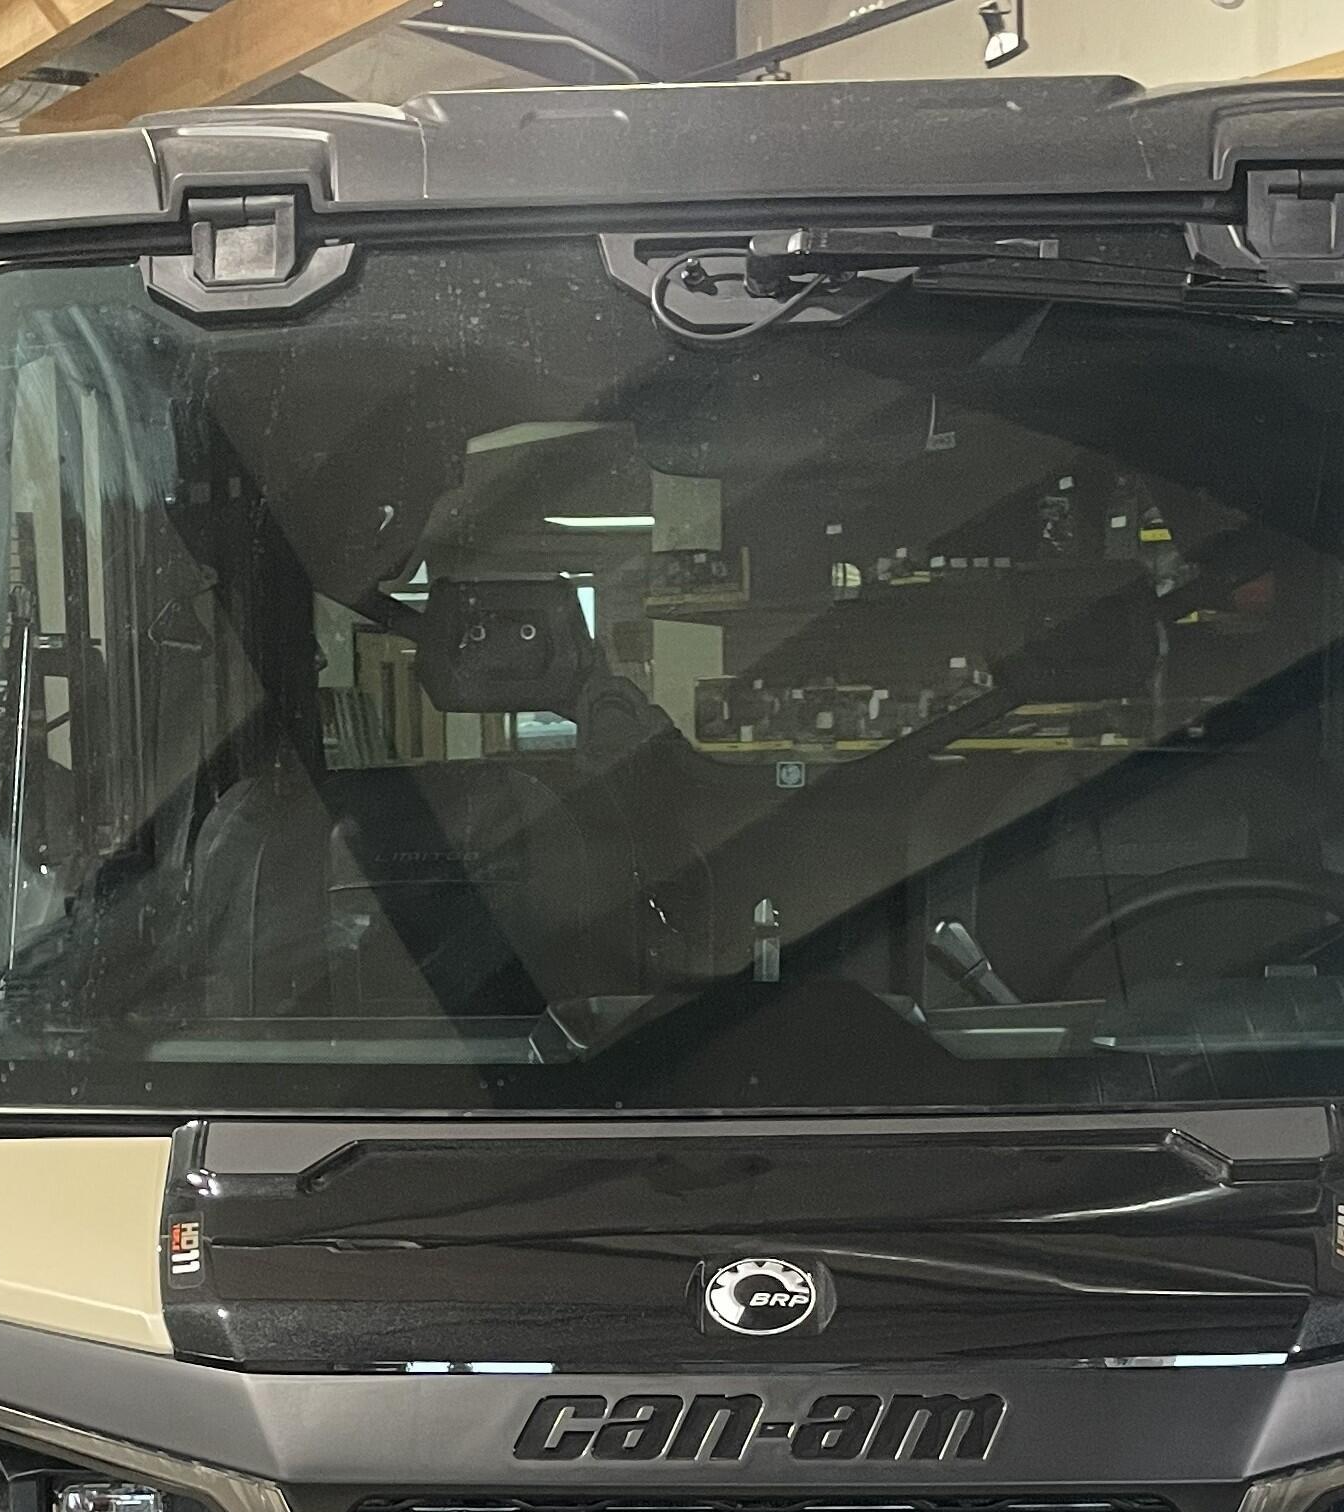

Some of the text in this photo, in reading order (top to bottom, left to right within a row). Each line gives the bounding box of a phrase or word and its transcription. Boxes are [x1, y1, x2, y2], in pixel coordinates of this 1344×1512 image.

[171, 1222, 201, 1275] HD11
[749, 1292, 810, 1308] BRP
[512, 1394, 1008, 1462] can-am
